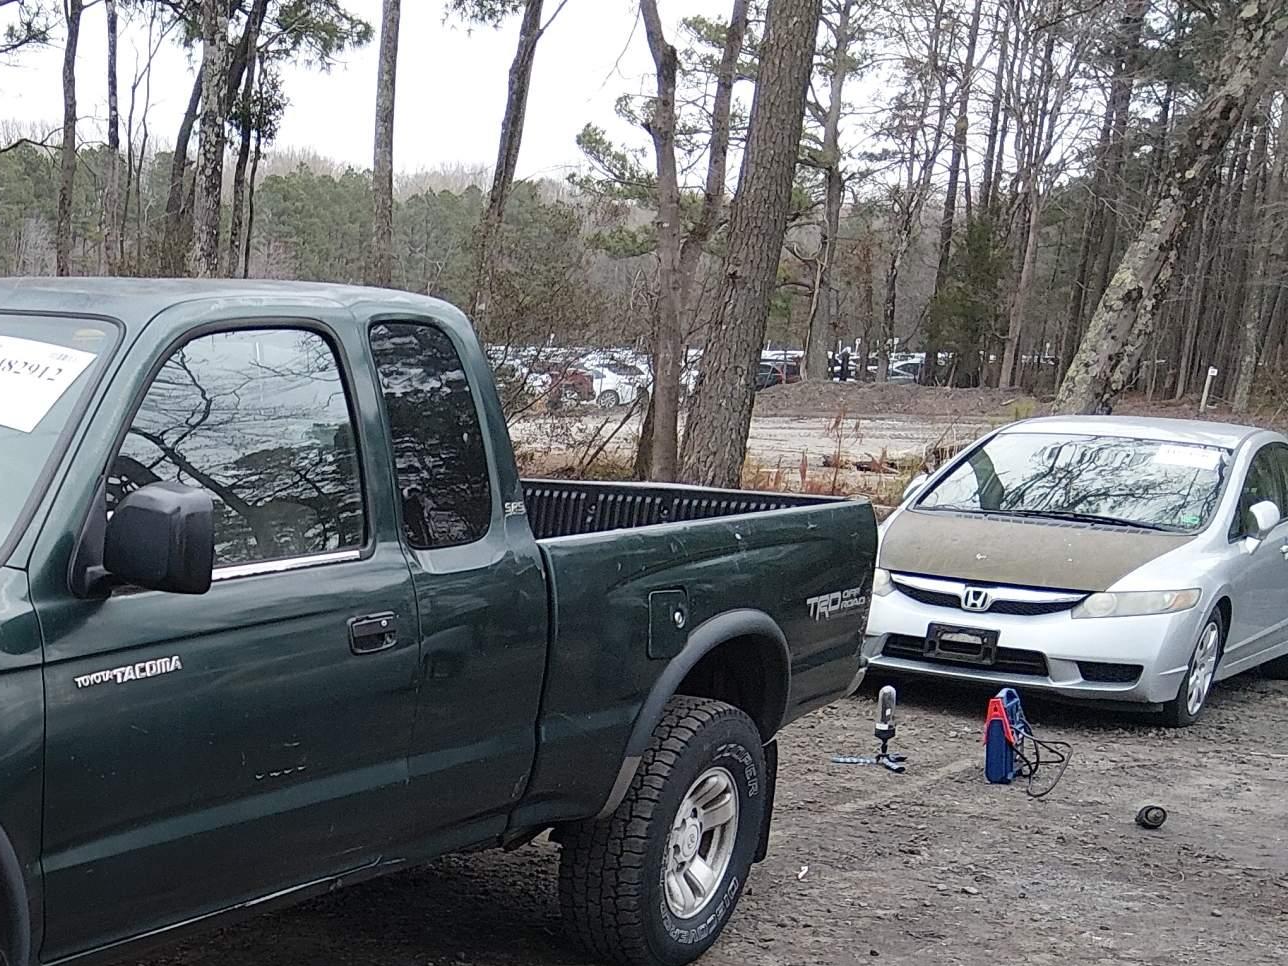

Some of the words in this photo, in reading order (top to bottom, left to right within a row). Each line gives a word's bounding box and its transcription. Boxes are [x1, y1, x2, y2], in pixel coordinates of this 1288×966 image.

[806, 591, 842, 621] TRD
[841, 596, 866, 609] ROAD
[112, 655, 183, 684] TACOMA
